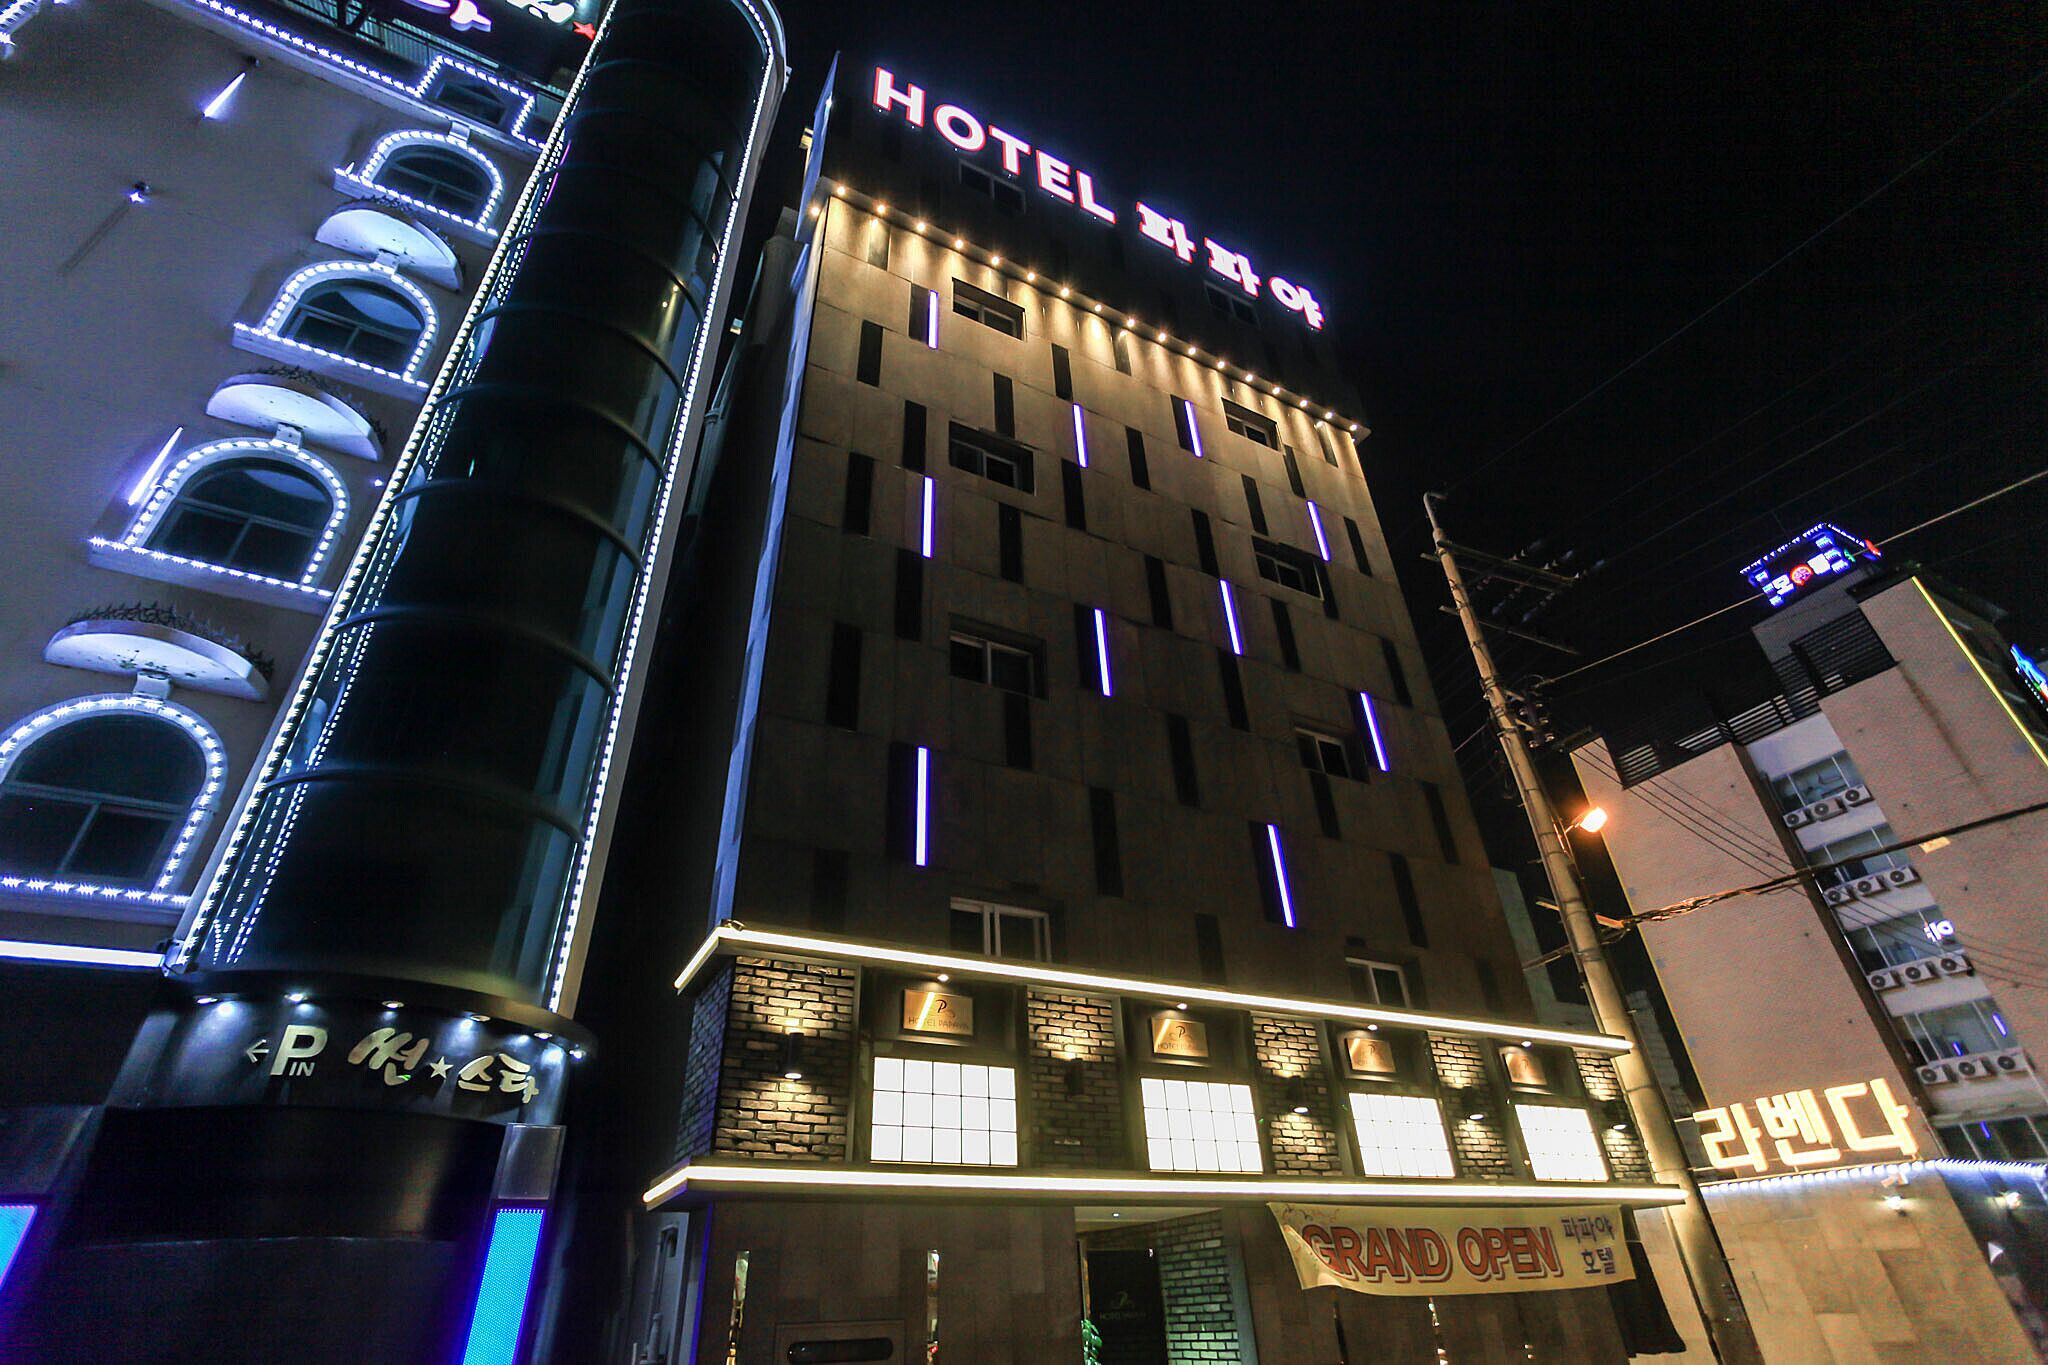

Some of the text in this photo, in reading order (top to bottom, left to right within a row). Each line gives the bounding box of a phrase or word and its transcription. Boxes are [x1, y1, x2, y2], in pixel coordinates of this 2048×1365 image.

[873, 66, 1325, 330] HOTEL 파파야
[270, 1024, 328, 1076] P
[289, 1060, 316, 1077] IN
[458, 1053, 539, 1104] 스타
[1692, 1077, 1919, 1173] 라벤다
[1302, 1224, 1564, 1283] GRAND OPEN
[1561, 1215, 1617, 1241] 파파야
[1581, 1246, 1617, 1275] 호텔
